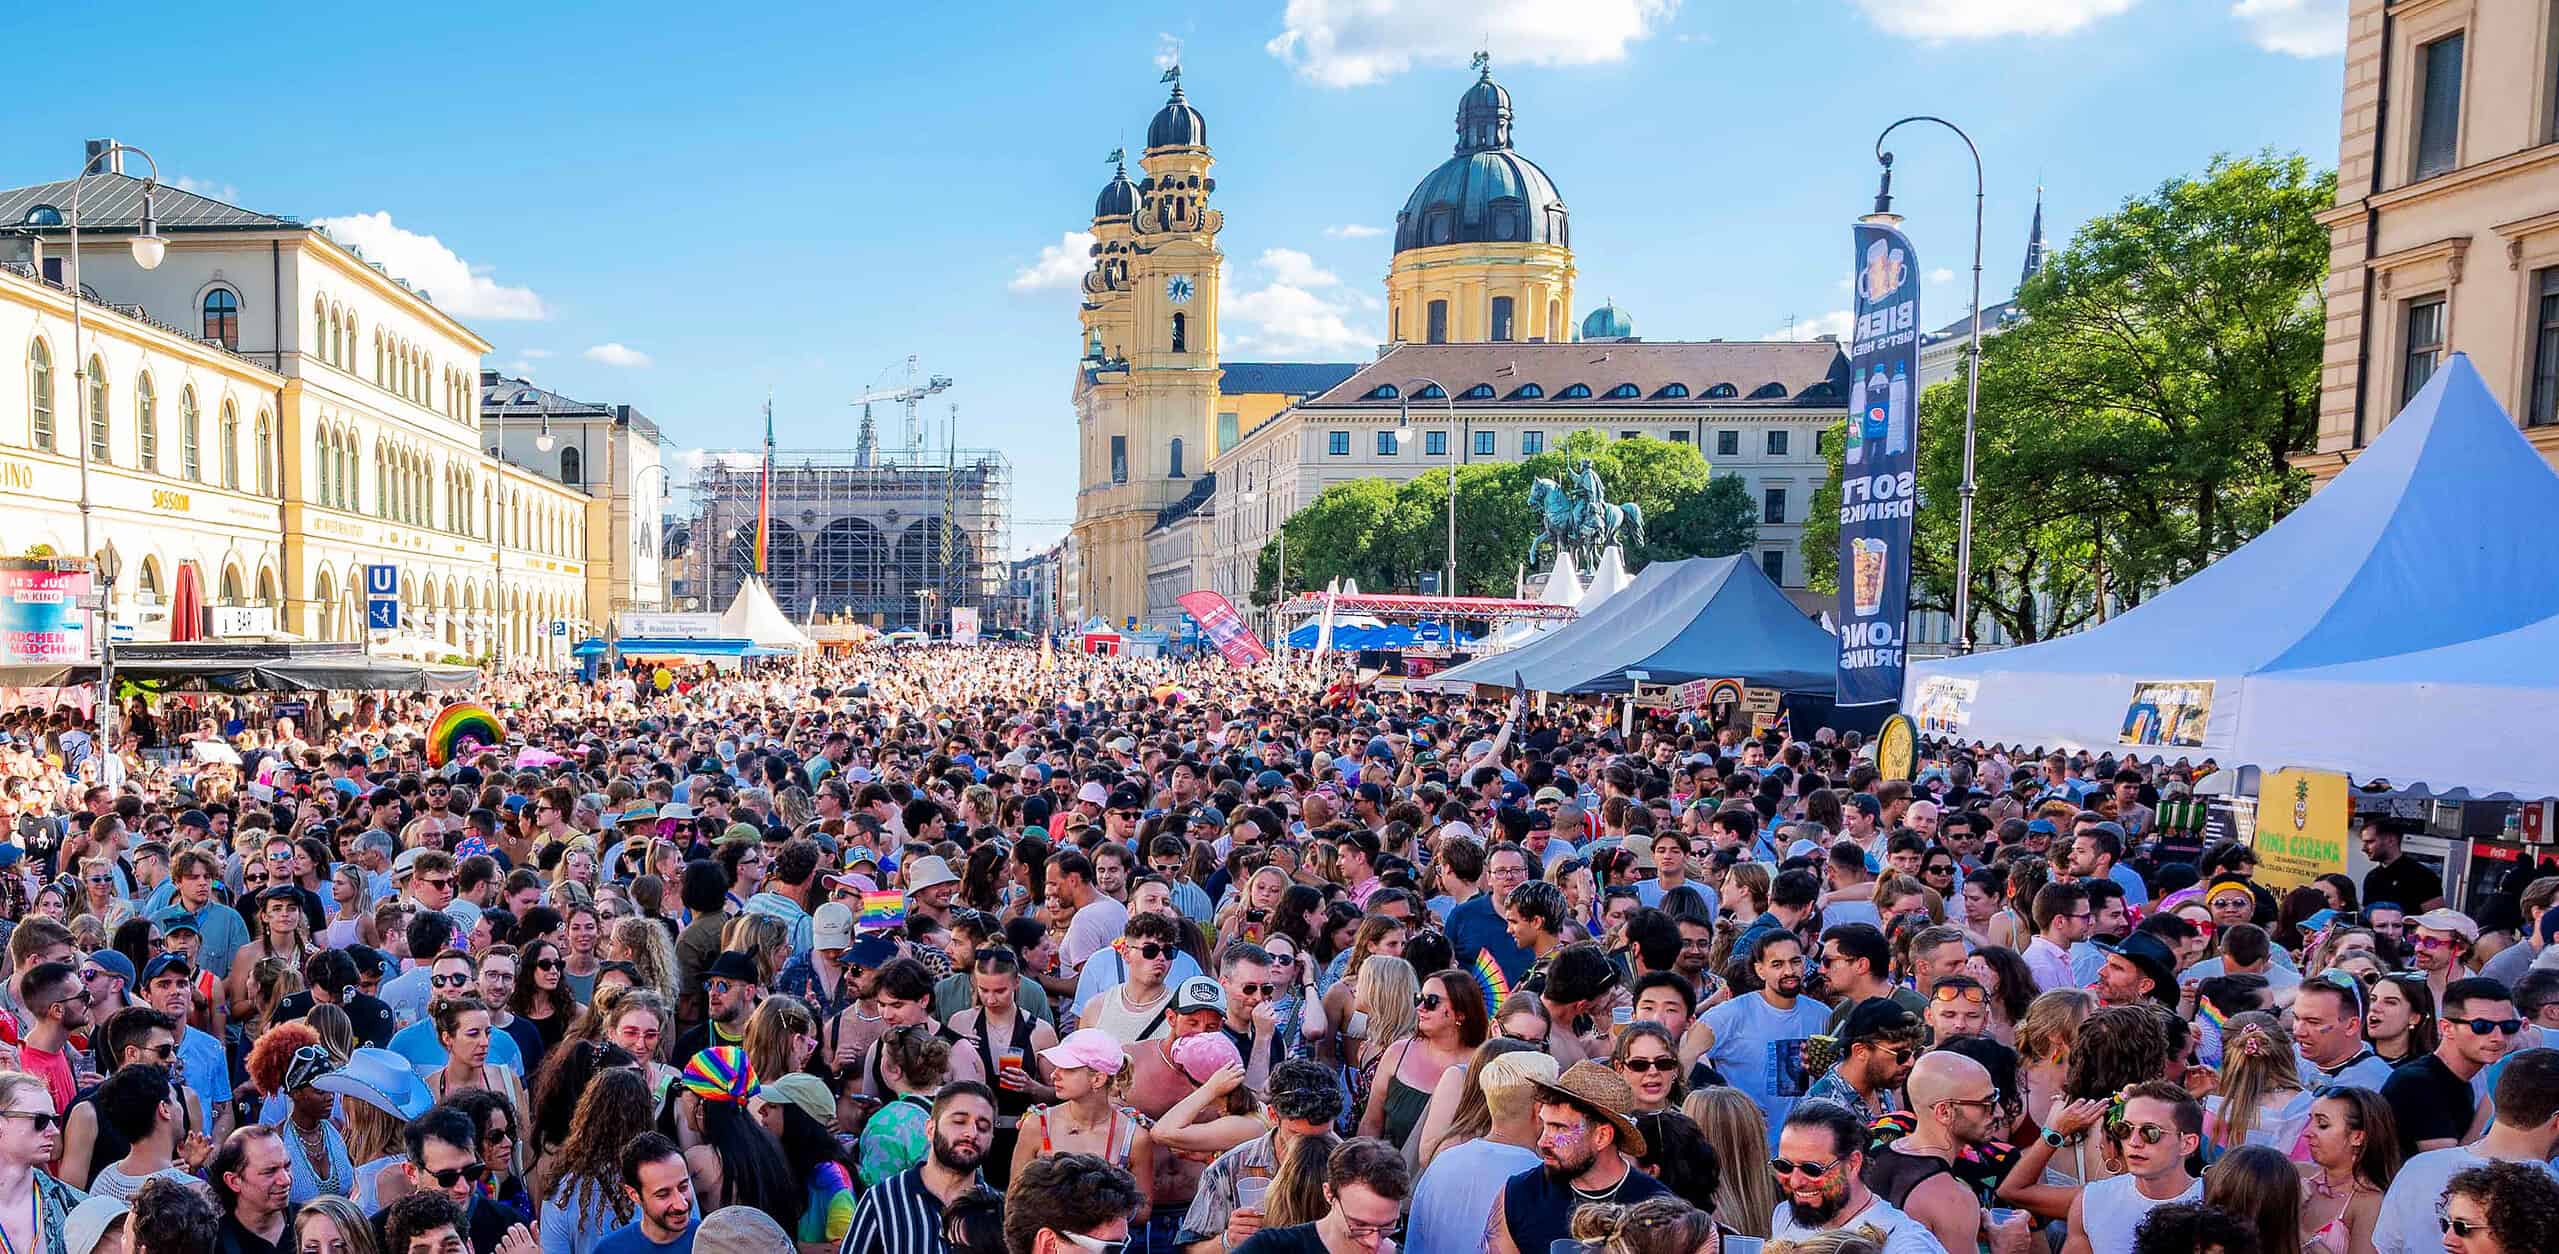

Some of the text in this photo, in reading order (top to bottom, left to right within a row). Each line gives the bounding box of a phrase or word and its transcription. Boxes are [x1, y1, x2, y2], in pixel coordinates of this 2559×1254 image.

[0, 462, 33, 489] INO
[41, 577, 69, 589] JULI
[373, 568, 392, 591] U
[32, 592, 60, 601] KINO
